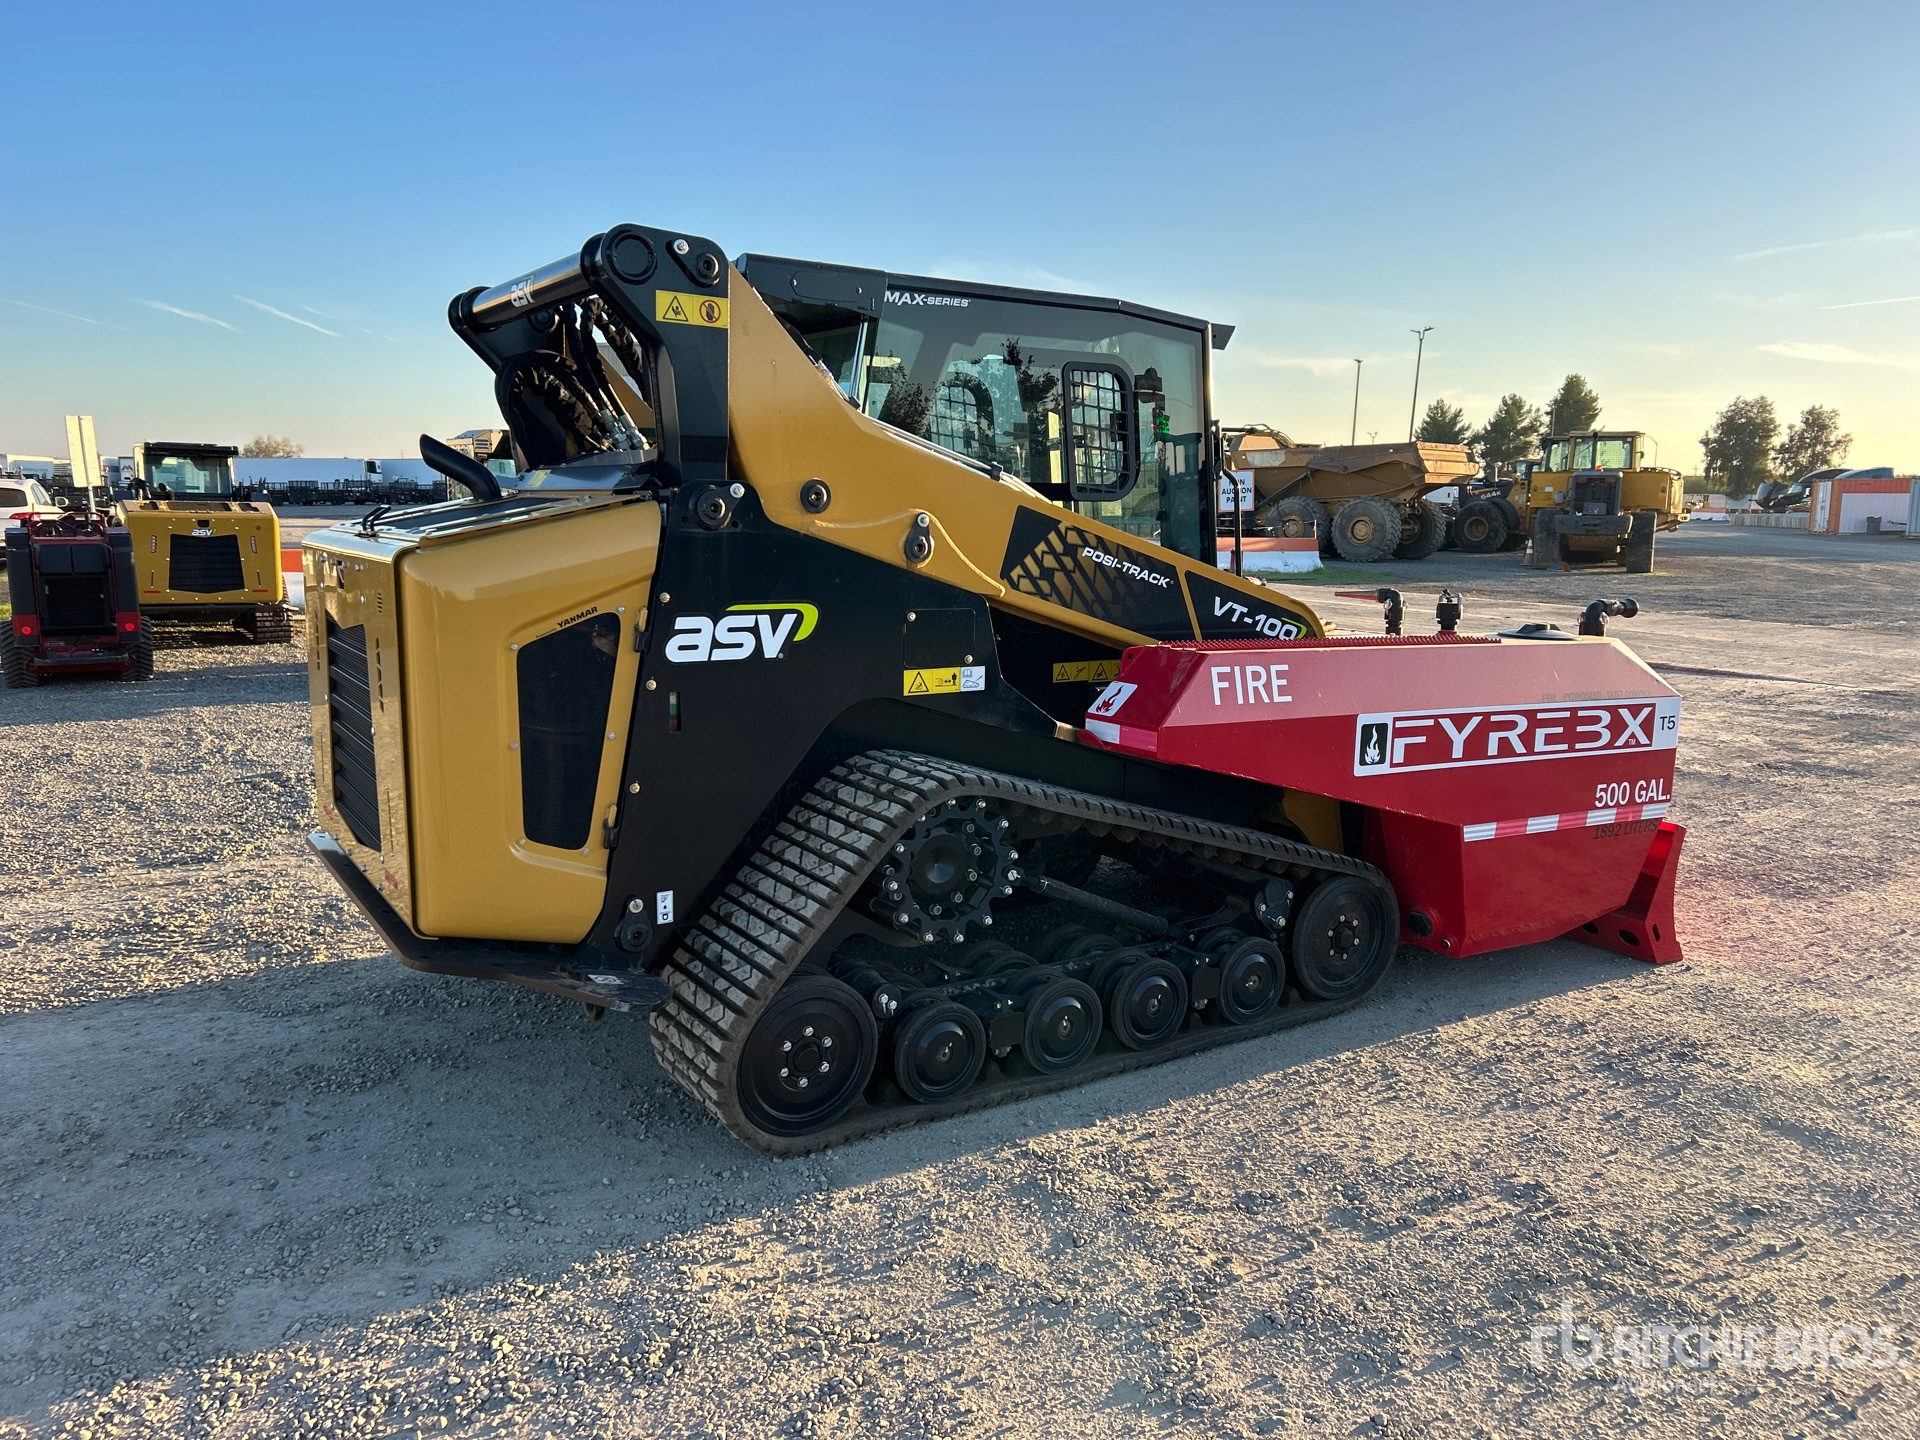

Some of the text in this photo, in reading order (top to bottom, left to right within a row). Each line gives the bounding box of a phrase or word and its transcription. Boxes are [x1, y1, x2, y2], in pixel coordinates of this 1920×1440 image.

[1222, 487, 1252, 495] AUCON
[1226, 496, 1247, 504] PAT
[557, 606, 598, 628] YANMAR
[1213, 596, 1298, 639] VT-100
[1210, 664, 1292, 705] FIRE
[1659, 715, 1676, 731] T5
[1595, 778, 1671, 808] 500 GAL.
[1593, 819, 1658, 839] 1892 LITERS
